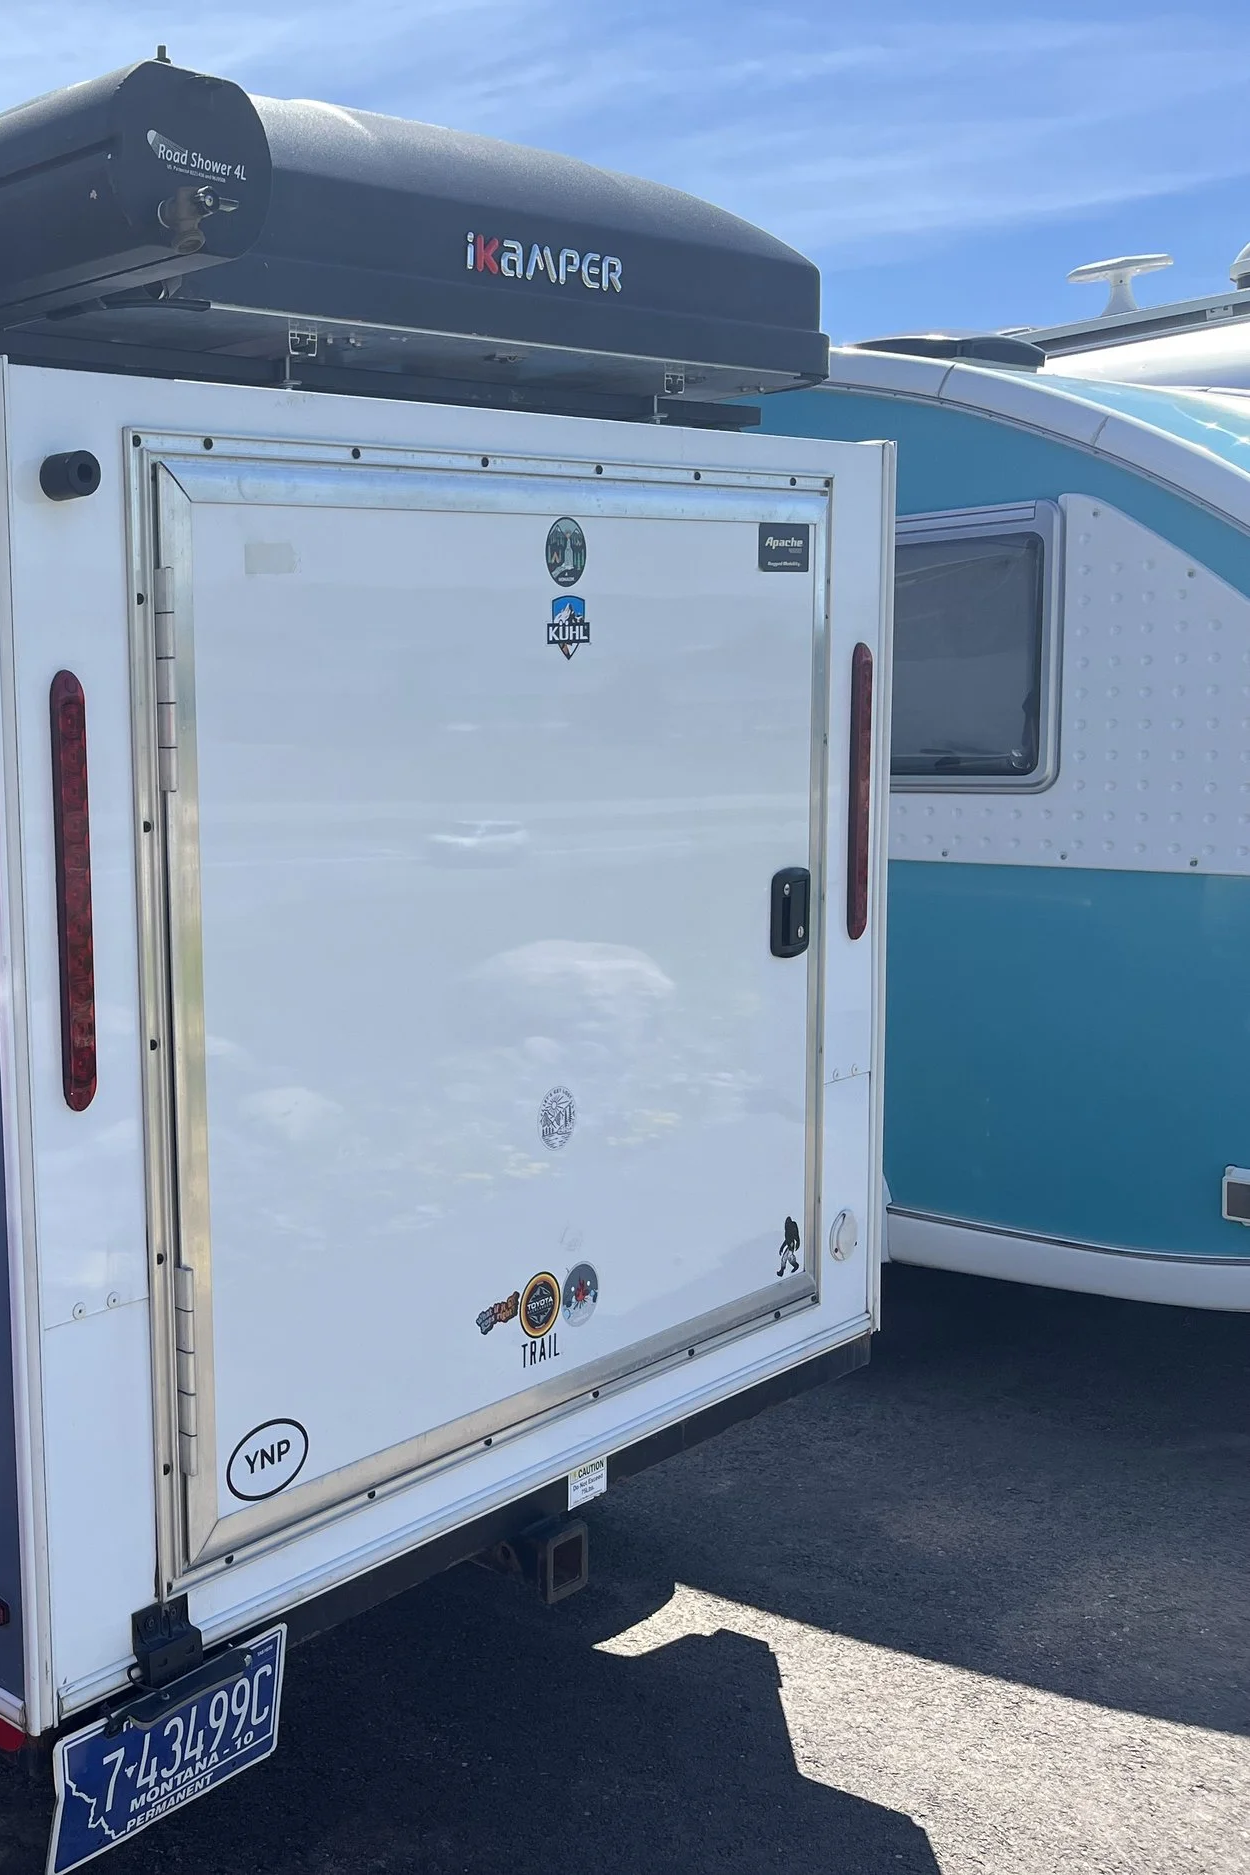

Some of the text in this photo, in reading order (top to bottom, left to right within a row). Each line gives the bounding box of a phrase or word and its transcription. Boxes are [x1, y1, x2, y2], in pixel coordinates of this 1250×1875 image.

[158, 143, 188, 166] Road
[190, 152, 232, 177] Shower
[234, 164, 247, 181] 4L
[765, 536, 803, 549] Apache
[549, 620, 588, 642] KÜHL
[527, 1296, 554, 1311] TOYOTA
[521, 1332, 560, 1368] TRAIL
[244, 1439, 291, 1475] YNP
[578, 1460, 604, 1478] CAUTION
[130, 1751, 219, 1813] MONTANA
[235, 1730, 254, 1749] 10
[125, 1772, 213, 1833] PERMANENT
